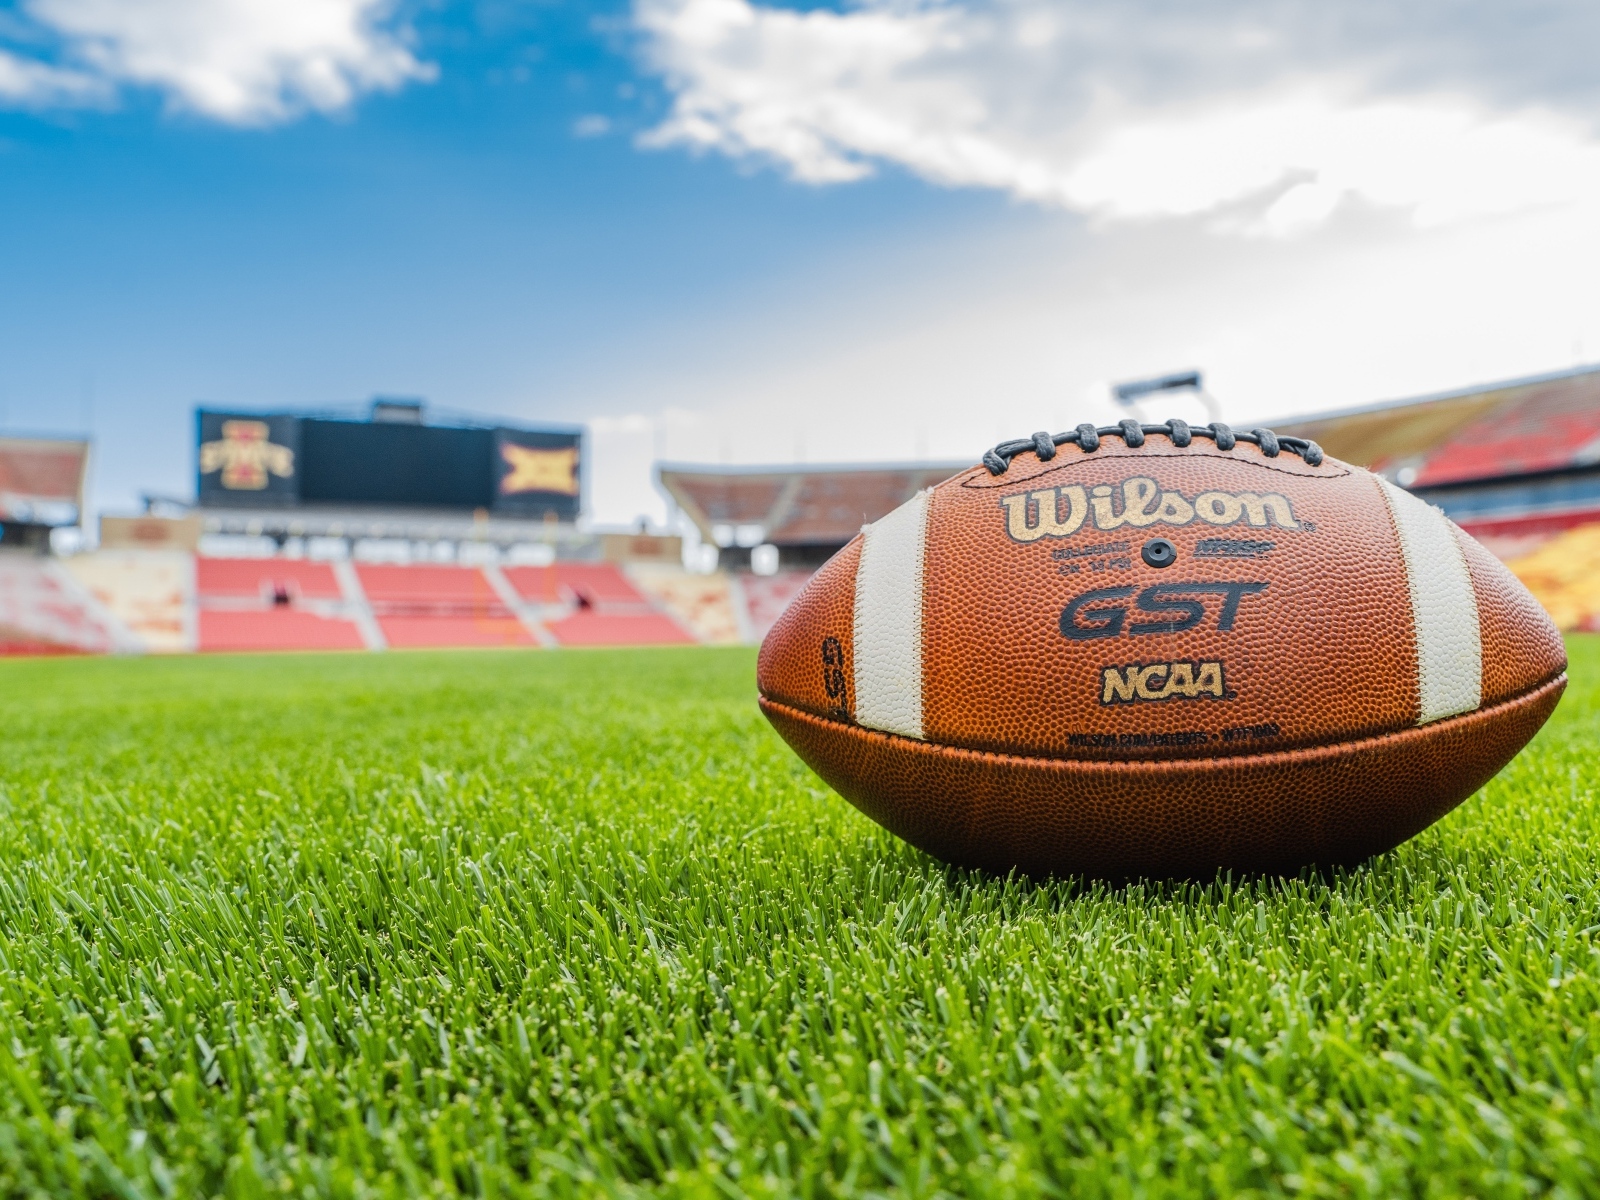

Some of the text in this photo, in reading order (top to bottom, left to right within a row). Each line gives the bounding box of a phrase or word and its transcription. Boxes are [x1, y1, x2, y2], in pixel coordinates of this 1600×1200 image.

[1002, 475, 1300, 543] Wilson
[1059, 582, 1270, 640] GST
[1100, 659, 1227, 707] NCAA
